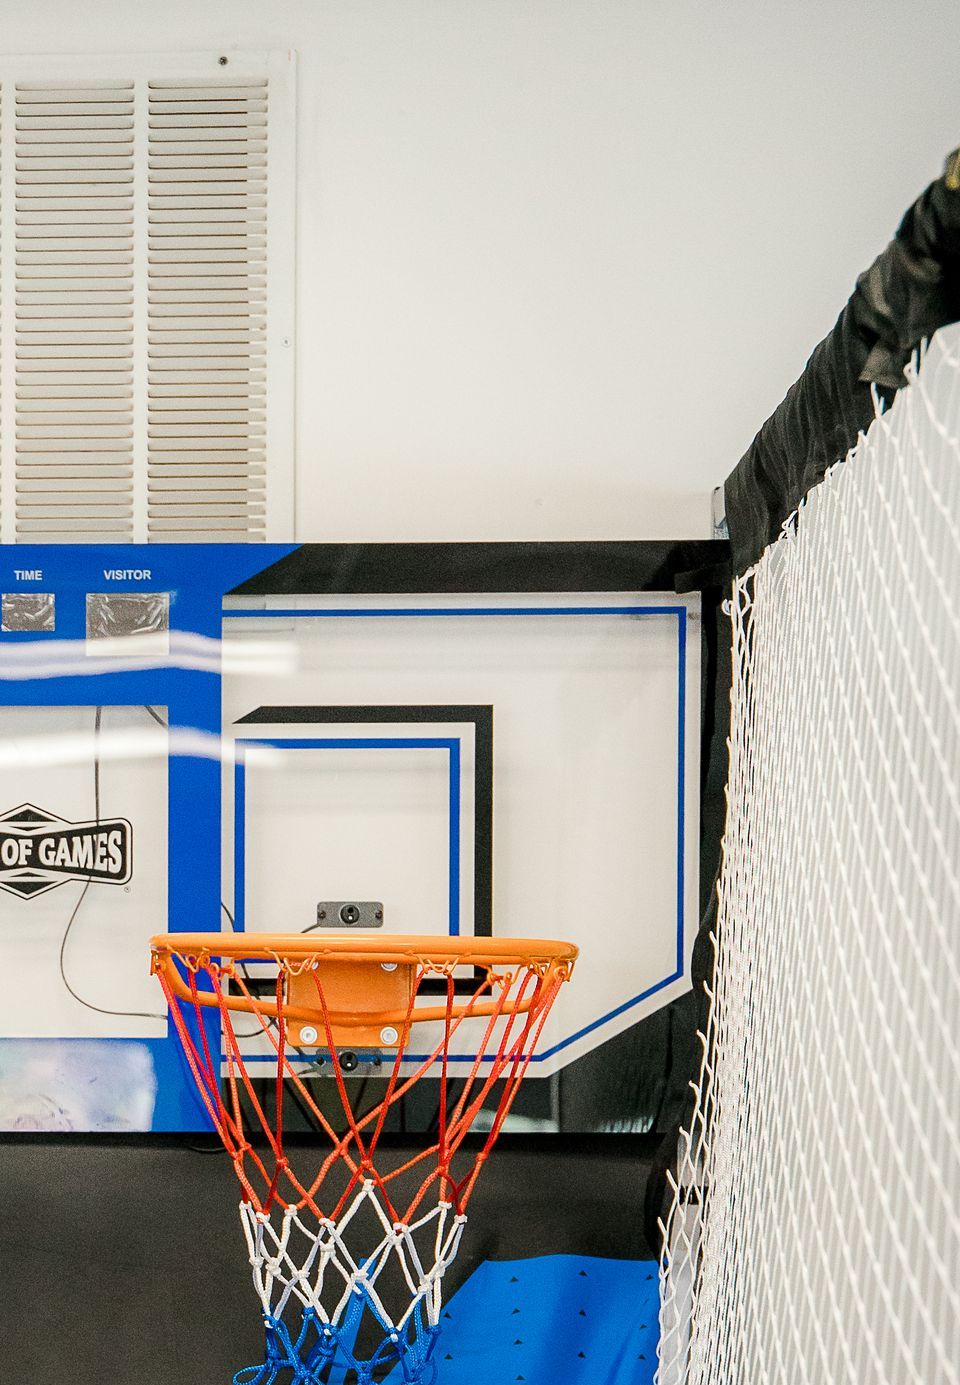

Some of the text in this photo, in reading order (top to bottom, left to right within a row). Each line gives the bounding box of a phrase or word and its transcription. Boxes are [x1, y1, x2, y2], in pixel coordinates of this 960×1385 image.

[13, 570, 43, 581] TIME
[103, 569, 152, 581] VISITOR
[0, 838, 33, 867] OF
[38, 830, 123, 874] GAMES
